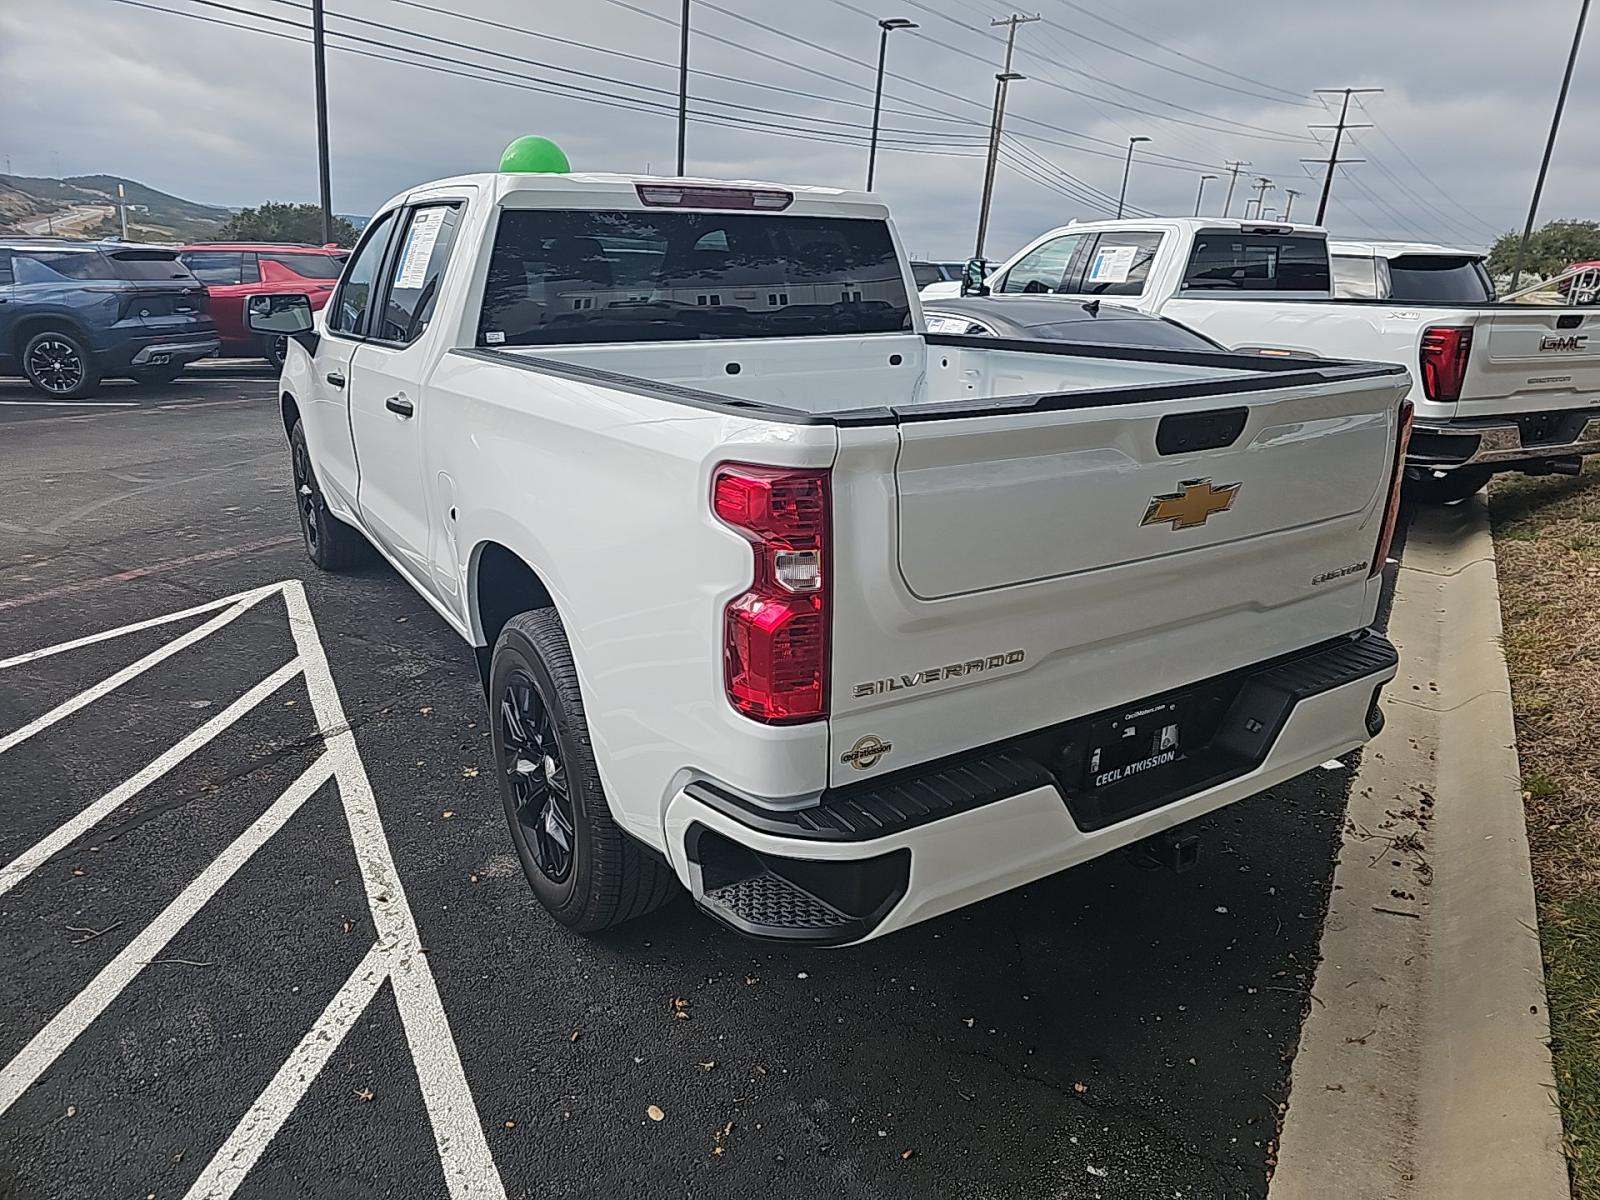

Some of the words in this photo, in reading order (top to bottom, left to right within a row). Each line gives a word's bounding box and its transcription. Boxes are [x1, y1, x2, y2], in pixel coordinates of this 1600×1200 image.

[1540, 336, 1588, 351] GMC
[853, 650, 1025, 697] SILVERADO
[1096, 768, 1122, 787] CECIL
[1124, 751, 1175, 777] ATKISSION
